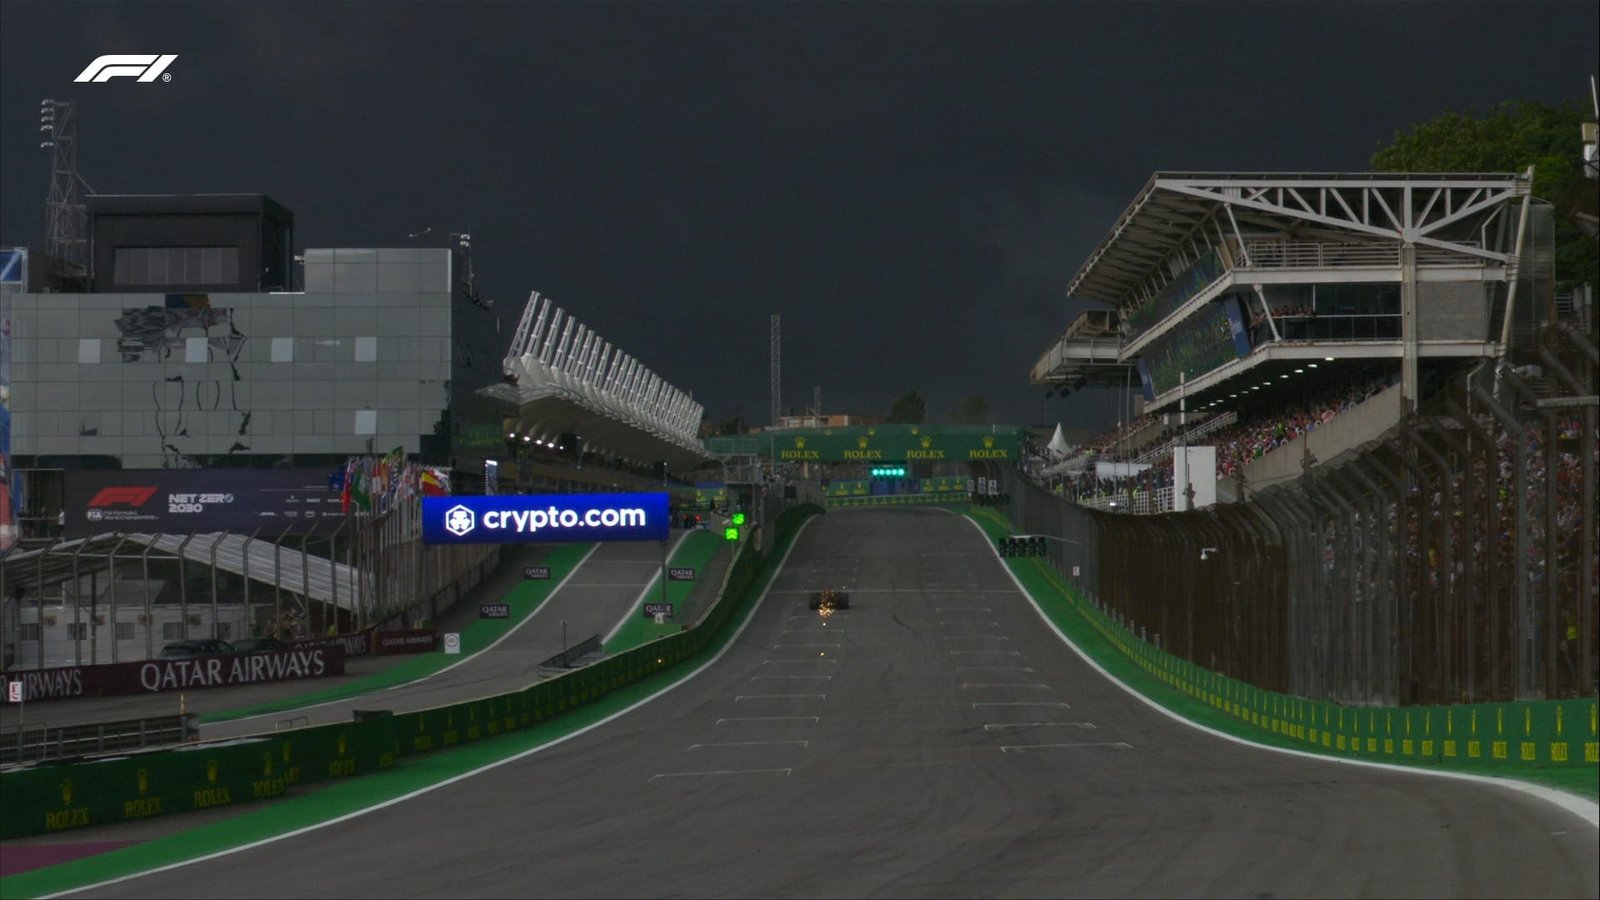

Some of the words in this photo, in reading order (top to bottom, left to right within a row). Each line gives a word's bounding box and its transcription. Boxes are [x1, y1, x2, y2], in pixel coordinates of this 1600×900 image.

[781, 450, 820, 460] ROLEX
[844, 450, 882, 459] ROLEX
[907, 449, 945, 459] ROLEX
[969, 449, 1008, 459] ROLEX
[169, 493, 197, 504] NET
[199, 493, 234, 504] ZERO
[168, 504, 203, 513] 2030
[483, 505, 646, 533] crypto.com
[141, 658, 224, 692] QATAR
[228, 650, 325, 684] AIRWAYS
[124, 796, 163, 818] ROLEX
[45, 806, 91, 830] ROLEX
